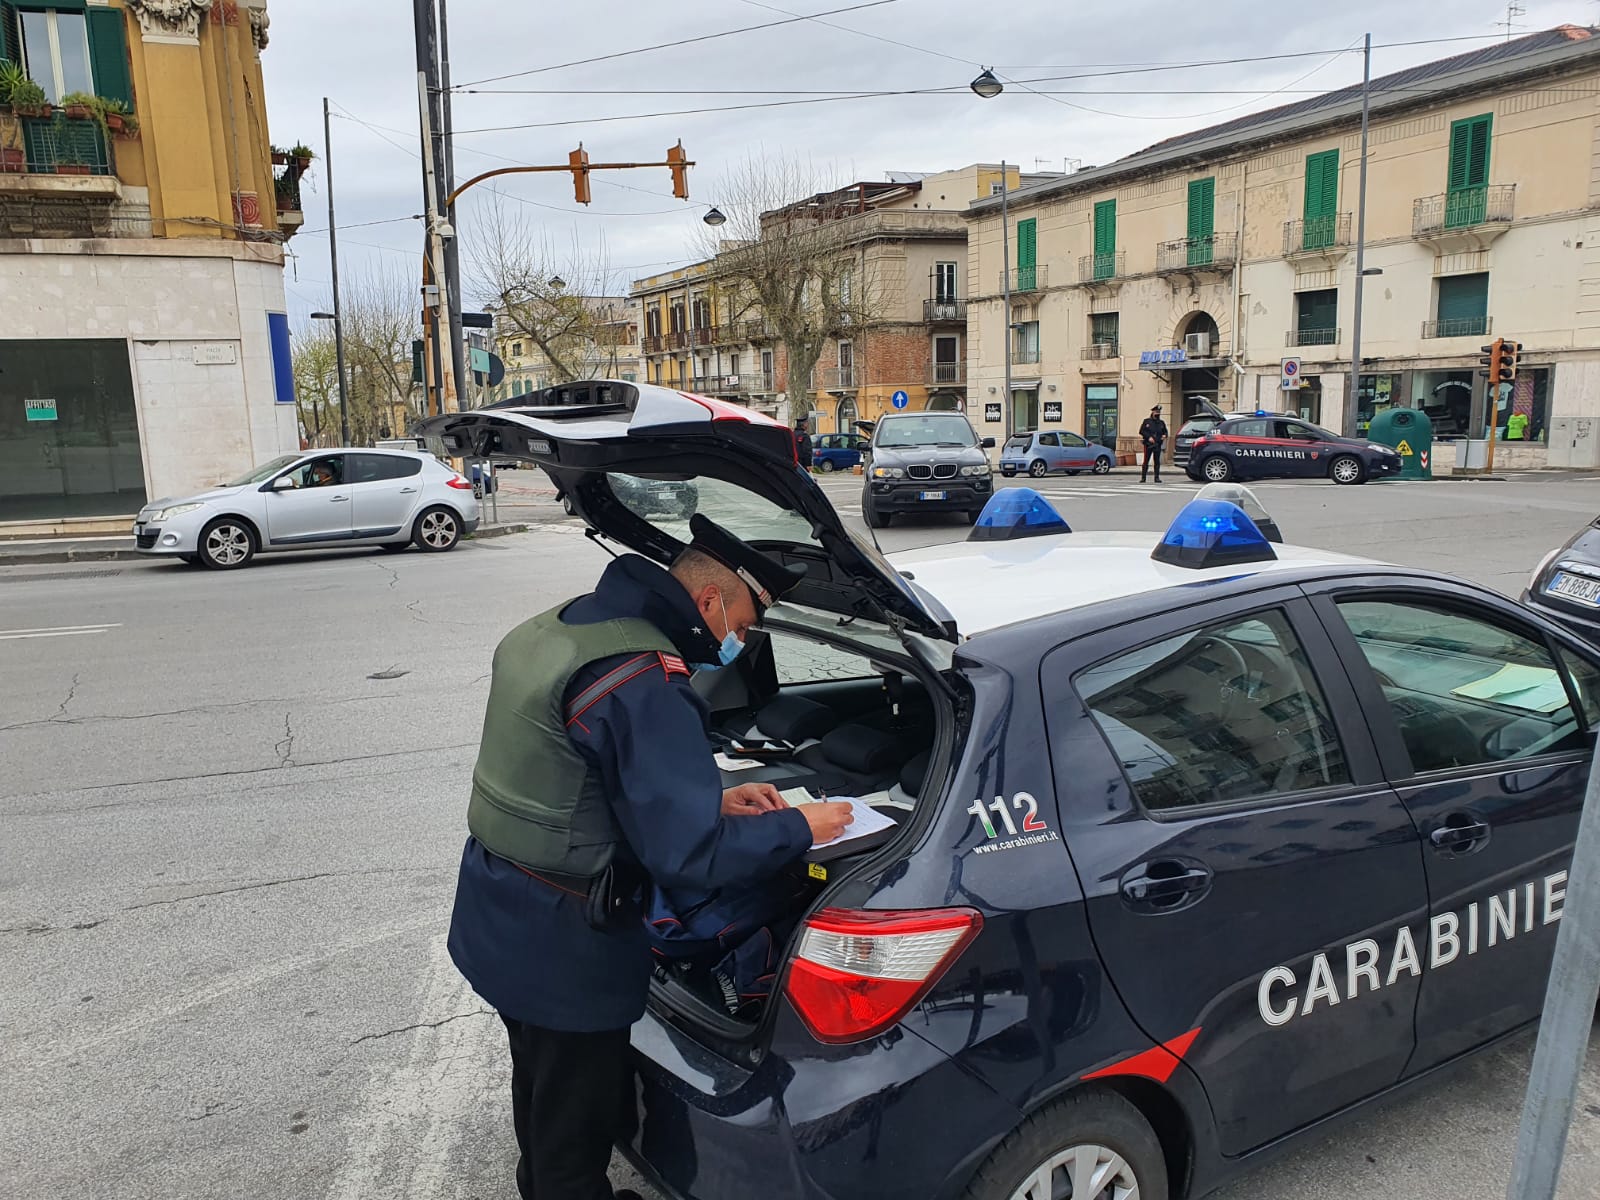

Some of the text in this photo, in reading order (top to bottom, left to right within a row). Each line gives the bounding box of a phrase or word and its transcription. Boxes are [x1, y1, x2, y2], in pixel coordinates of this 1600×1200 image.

[1140, 349, 1185, 363] HOTEL
[1235, 449, 1305, 459] CARABINIERI
[967, 792, 1047, 838] 112
[973, 831, 1058, 855] www.carabinieri.it
